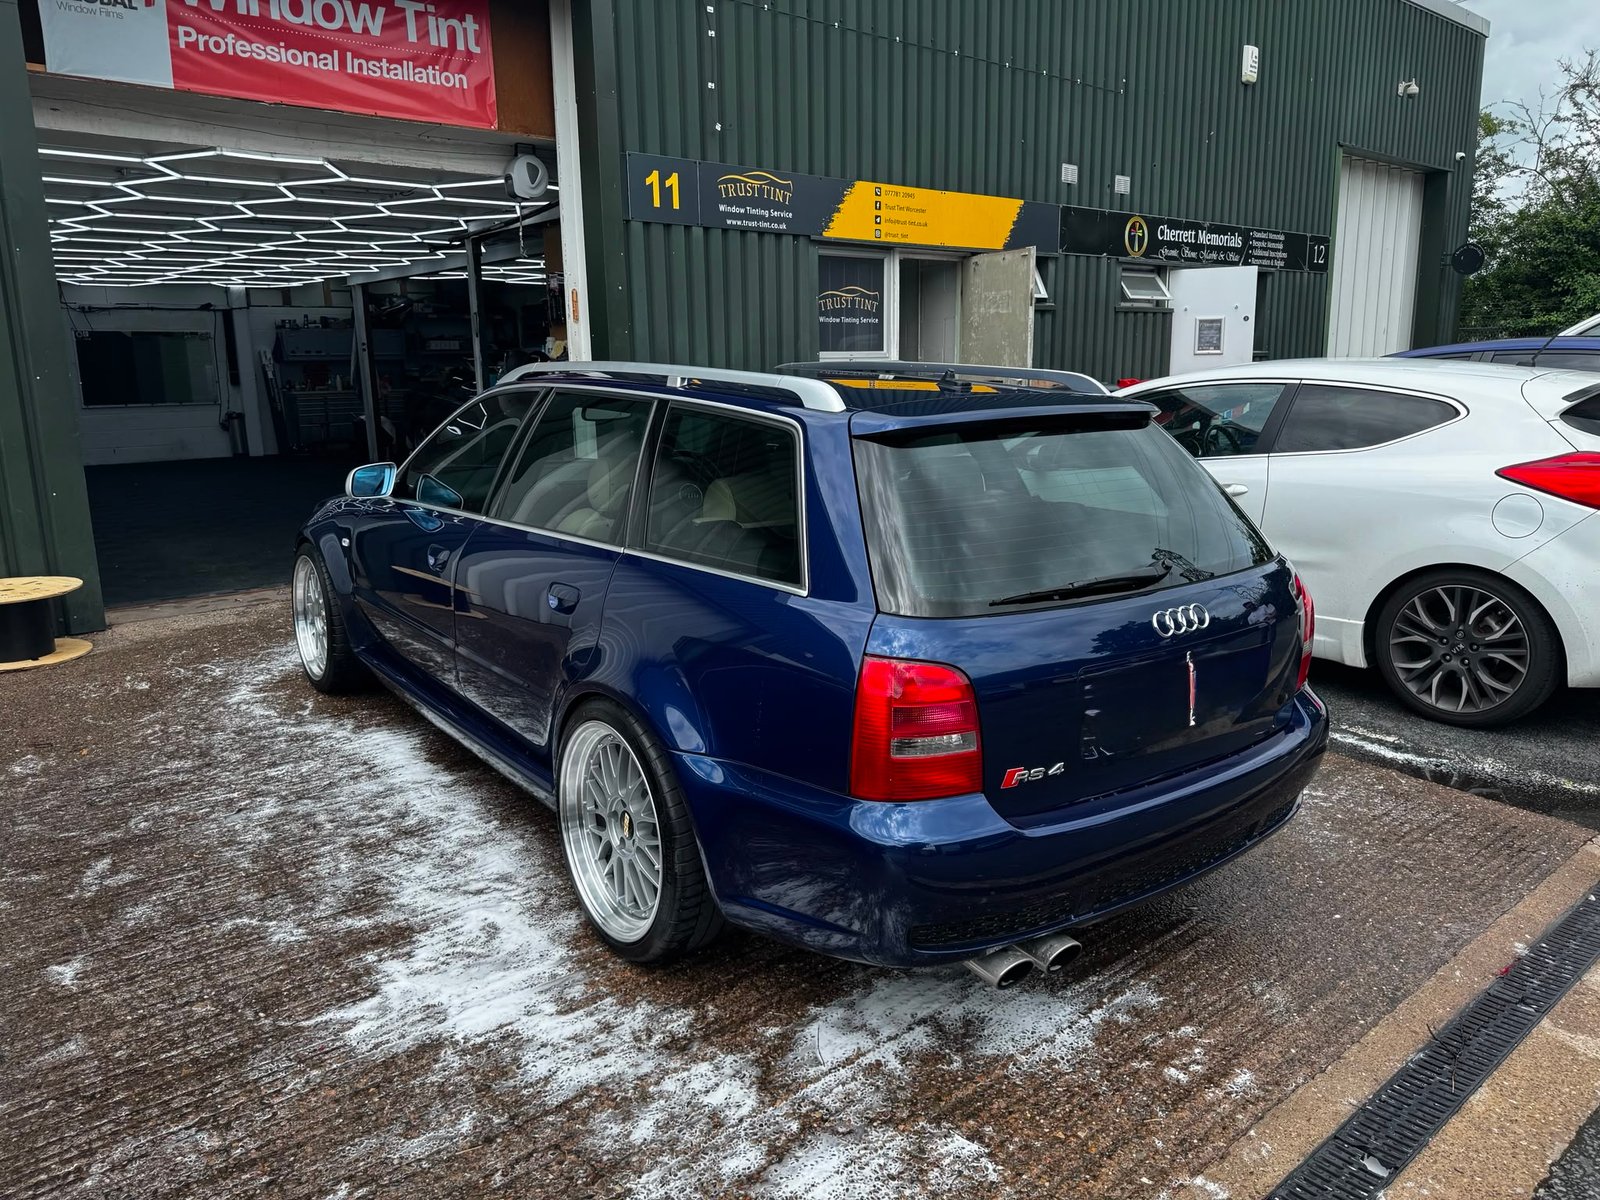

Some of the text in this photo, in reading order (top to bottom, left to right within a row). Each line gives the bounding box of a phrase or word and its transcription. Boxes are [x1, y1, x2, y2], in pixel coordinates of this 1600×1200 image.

[56, 1, 124, 19] Window Films
[395, 1, 481, 54] Tint
[178, 26, 468, 89] Professional Installation
[645, 170, 680, 210] 11
[718, 183, 793, 206] TRUST TINT
[719, 204, 793, 219] Window Tinting Service
[726, 218, 787, 230] www.trust-tint.co.uk
[1157, 224, 1243, 248] Cherrett Memorials
[1252, 231, 1285, 241] Standard Memorials
[1252, 240, 1284, 250] Bespoke Memorials
[1218, 251, 1225, 261] &
[1313, 244, 1326, 264] 12
[819, 297, 879, 312] TRUST TINT
[819, 316, 879, 325] Window Tinting Service
[1048, 762, 1065, 776] 4
